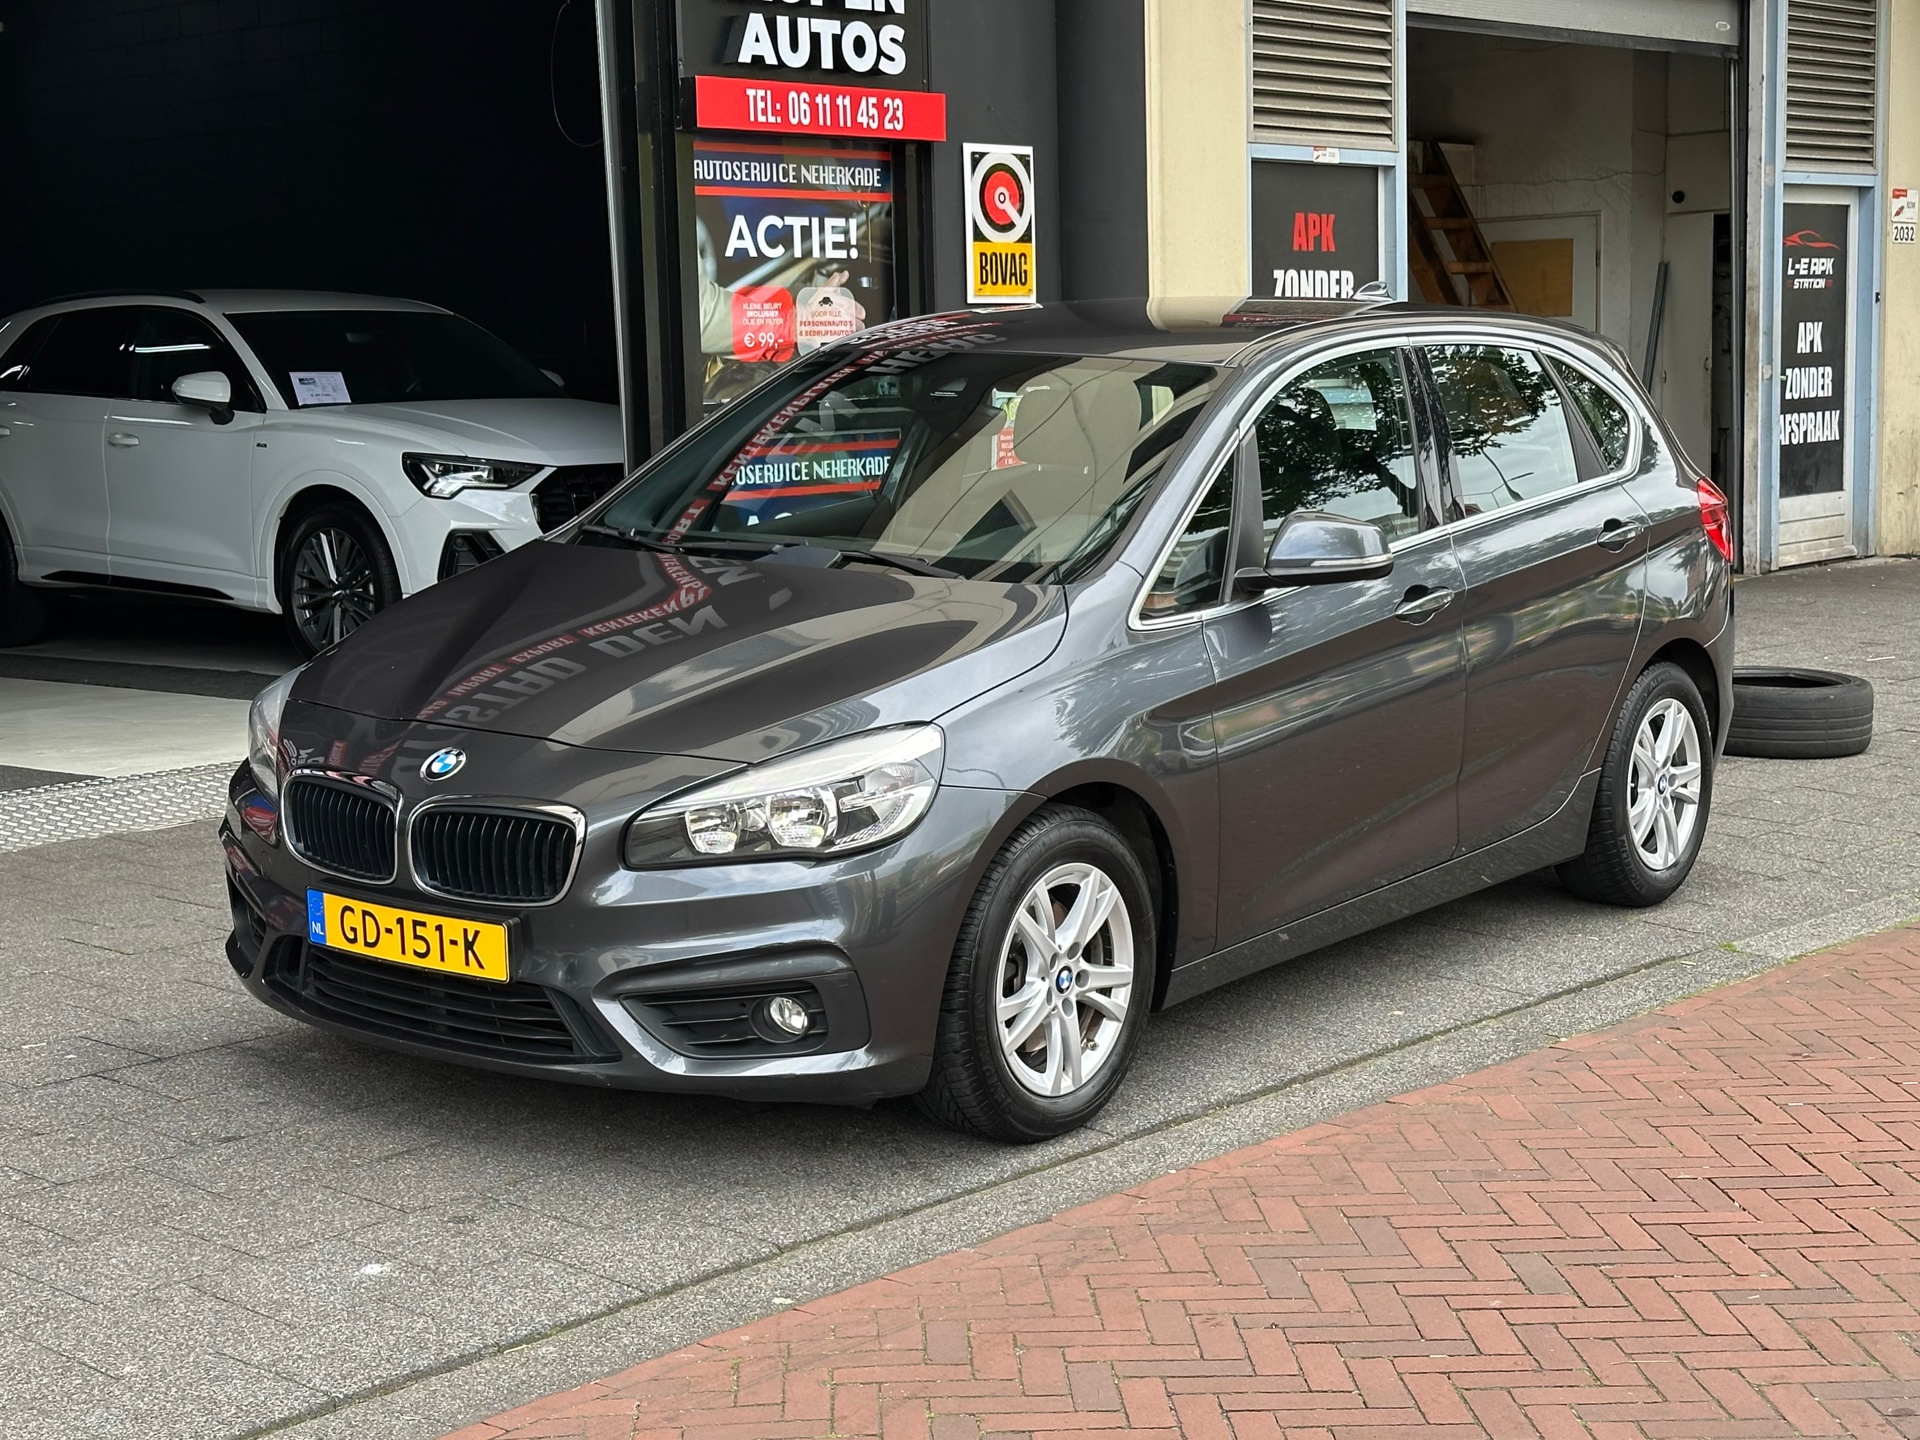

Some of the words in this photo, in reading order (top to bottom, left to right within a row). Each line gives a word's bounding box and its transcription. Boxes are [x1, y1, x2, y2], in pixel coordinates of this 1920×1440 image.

[737, 12, 906, 75] AUTOS
[746, 88, 782, 123] TEL:
[788, 91, 811, 126] 06
[815, 93, 832, 127] 11
[836, 94, 852, 128] 11
[857, 96, 879, 130] 45
[883, 97, 904, 131] 23
[694, 160, 798, 184] AUTOSERVICE
[801, 164, 882, 187] NEHERKADE
[725, 214, 859, 260] ACTIE!
[1293, 212, 1336, 253] APK
[1894, 226, 1915, 242] 2032
[979, 252, 1028, 287] BOVAG
[1787, 257, 1809, 276] L-E
[1810, 257, 1835, 275] APK
[1273, 269, 1355, 299] ZONDER
[1793, 278, 1826, 289] STATION
[746, 310, 780, 318] INCLUSIEF
[811, 310, 828, 318] VOOR
[743, 332, 756, 348] €
[758, 332, 785, 349] 99,-
[1796, 321, 1823, 354] APK
[1785, 366, 1833, 400] ZONDER
[312, 920, 325, 936] NL
[339, 904, 486, 970] GD-151-K
